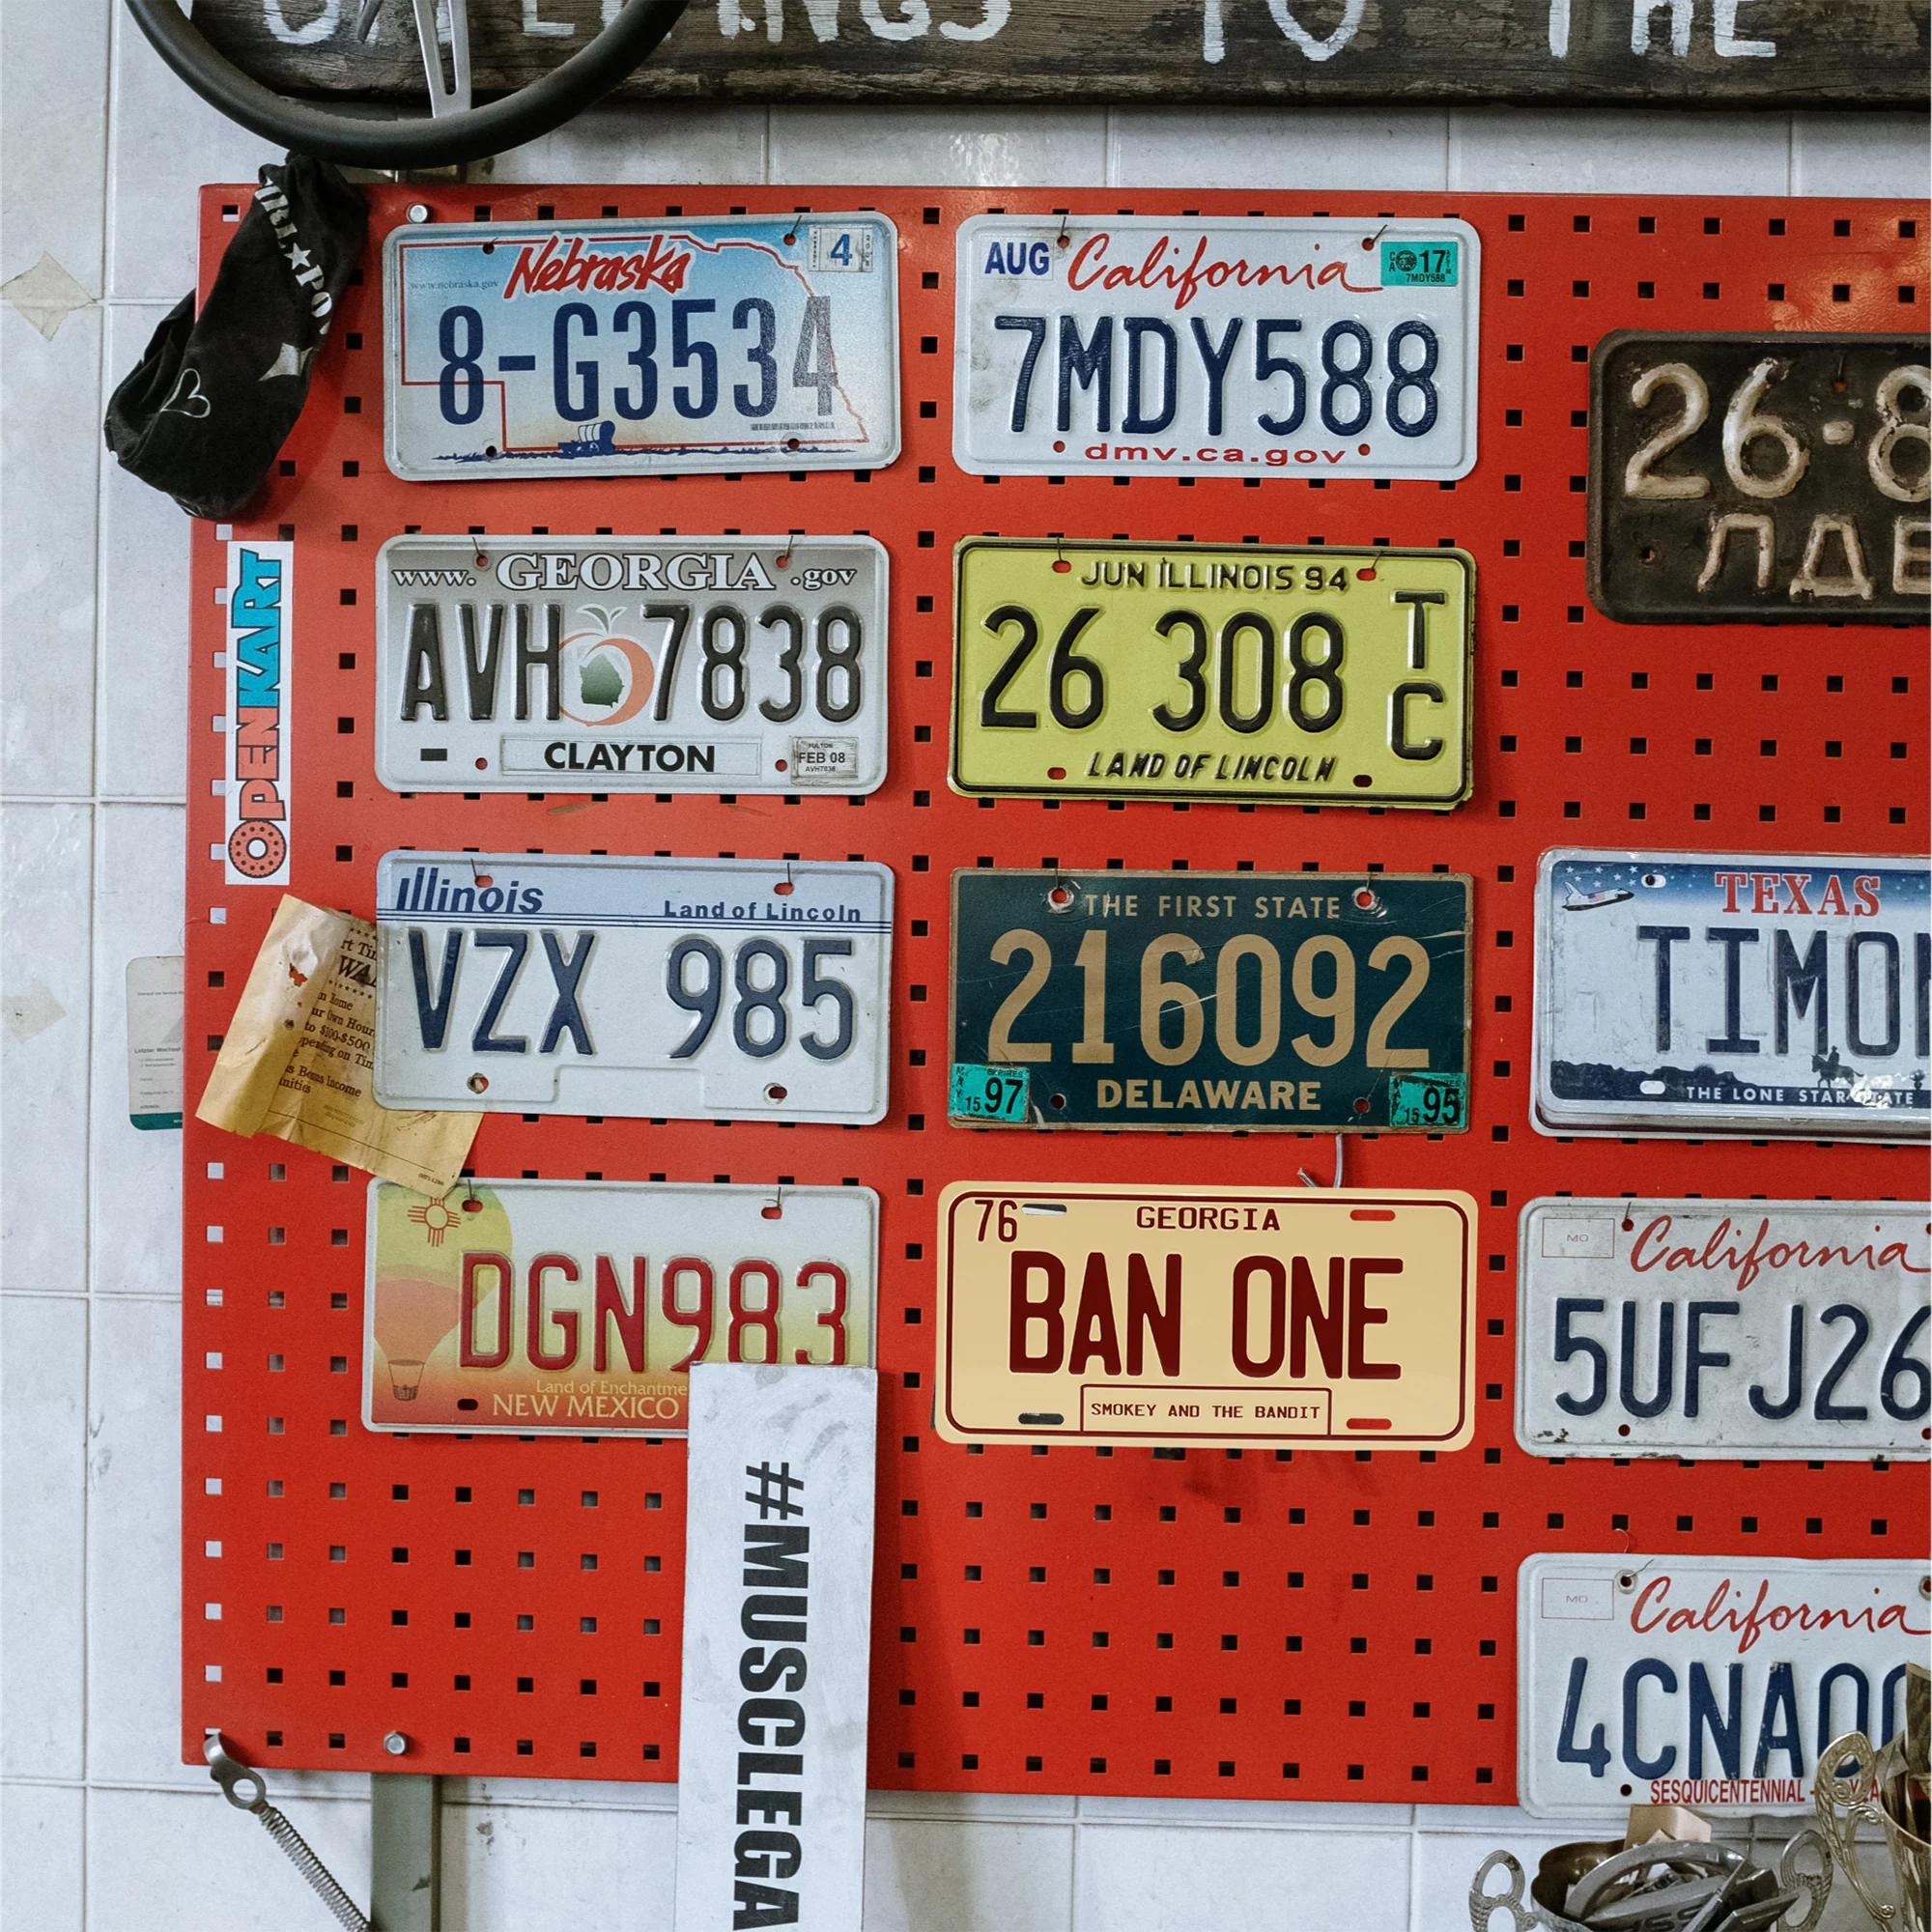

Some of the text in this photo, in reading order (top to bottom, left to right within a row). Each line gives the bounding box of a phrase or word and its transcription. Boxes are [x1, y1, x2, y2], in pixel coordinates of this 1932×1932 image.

[503, 232, 692, 298] Nebraska
[830, 234, 853, 266] 4
[984, 241, 1050, 276] AUG
[1419, 249, 1446, 273] 17
[1067, 233, 1383, 310] California
[1406, 273, 1446, 283] 7MDY588
[438, 296, 838, 424] 8-G3534
[994, 314, 1439, 437] 7MDY588
[1084, 442, 1347, 467] dmv.ca.gov
[391, 553, 858, 591] www. GEORGIA .gov
[1081, 559, 1350, 592] JUN ILLINOIS 94
[980, 605, 1345, 734] 26 308
[543, 742, 716, 774] CLAYTON
[798, 752, 846, 764] FEB 08
[1087, 753, 1339, 783] LAND OF LINCOLN
[396, 867, 544, 915] Illinois
[1085, 893, 1342, 920] THE FIRST STATE
[1715, 872, 1881, 917] TEXAS
[663, 899, 862, 923] Land of Lincoln
[408, 929, 856, 1061] VZX 985
[987, 929, 1432, 1069] 216092
[965, 1076, 1024, 1115] 15 97
[1095, 1079, 1322, 1112] DELAWARE
[1422, 1087, 1462, 1123] 95
[1686, 1086, 1915, 1105] THE LONE STAR TATE
[974, 1199, 1018, 1242] 76
[1135, 1206, 1282, 1232] GEORGIA
[1566, 1234, 1590, 1243] MO
[1631, 1214, 1930, 1292] California
[459, 1252, 848, 1373] DGN983
[1009, 1250, 1405, 1381] BAN ONE
[535, 1378, 689, 1397] Land of Enchantme
[492, 1393, 680, 1420] NEW MEXICO
[1090, 1402, 1321, 1420] SMOKEY AND THE BANDIT
[1565, 1595, 1589, 1604] MO
[1631, 1576, 1930, 1654] California
[731, 1461, 811, 1931] #MUSCLEGA
[1649, 1778, 1806, 1804] SESQUICENTENNIAL
